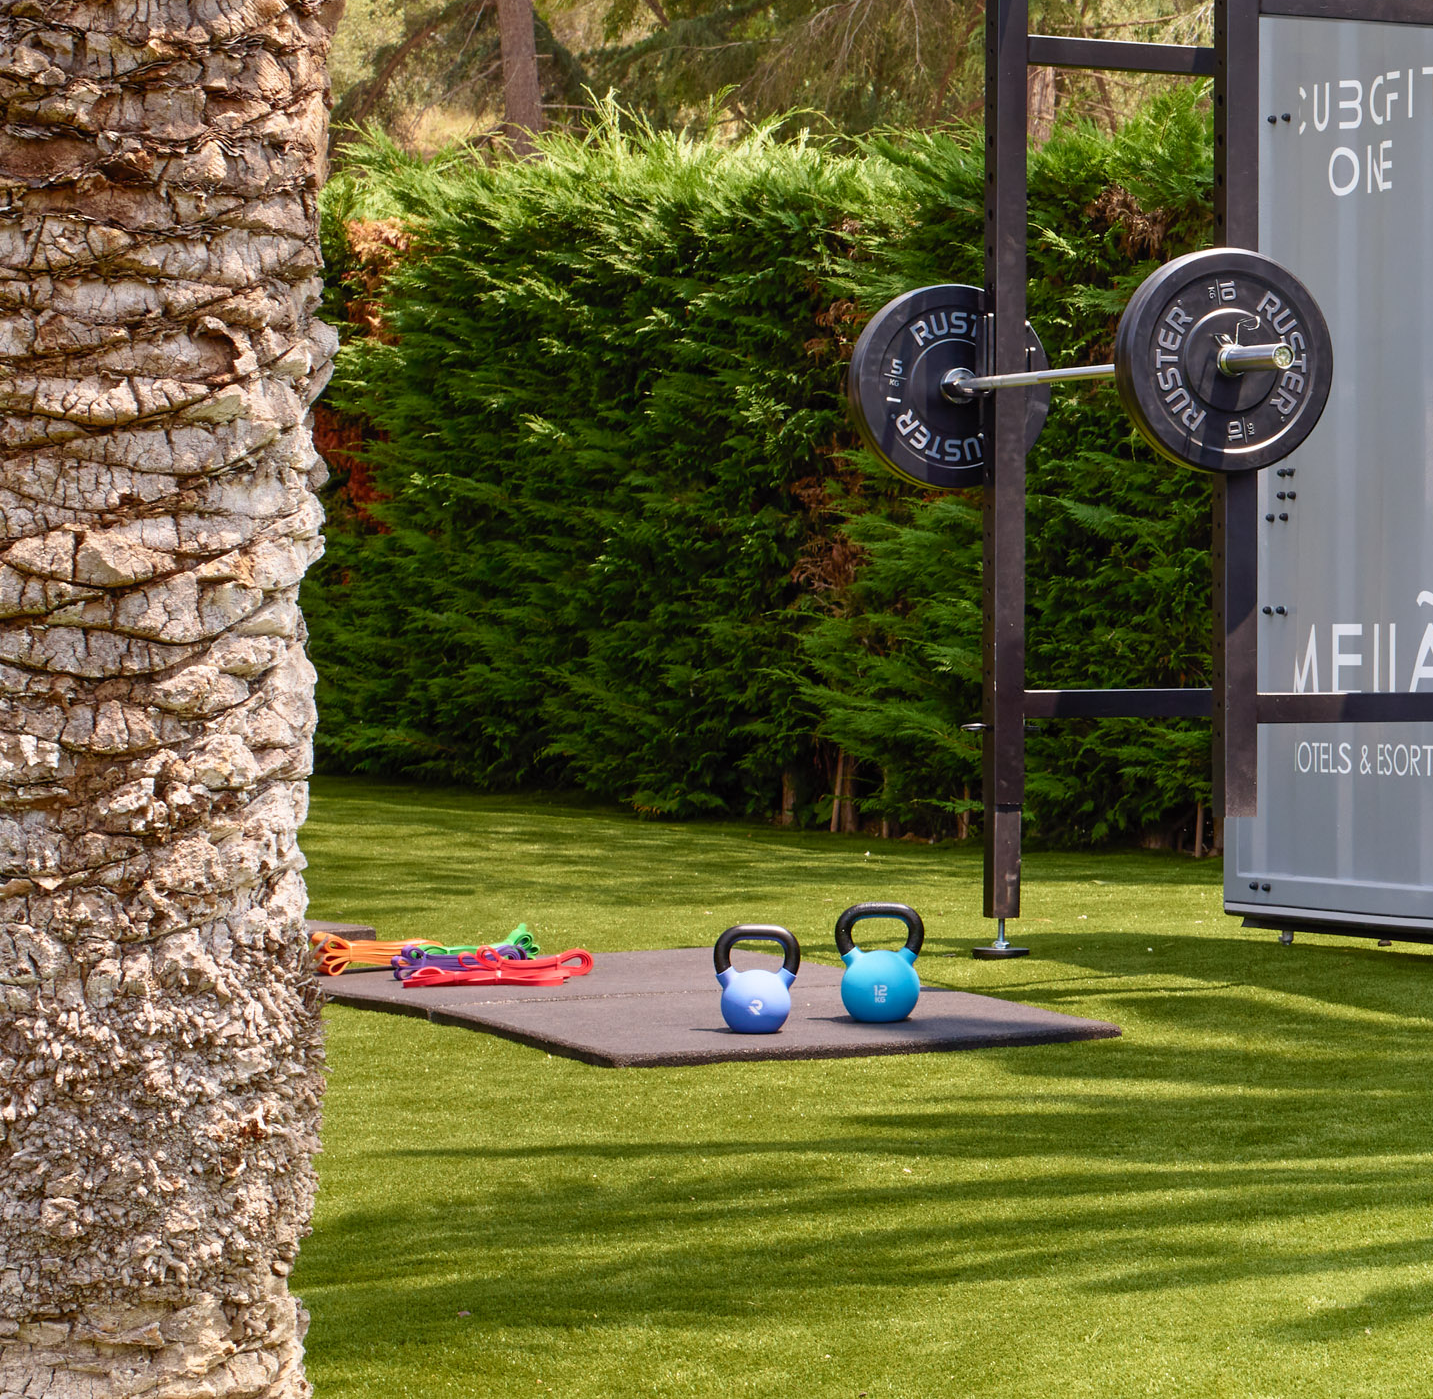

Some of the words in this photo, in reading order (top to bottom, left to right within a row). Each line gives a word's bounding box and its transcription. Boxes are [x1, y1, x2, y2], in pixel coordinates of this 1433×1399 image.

[1327, 139, 1393, 197] ONE
[1219, 280, 1237, 302] 10
[1256, 290, 1307, 416] RUSTER
[1155, 306, 1207, 432] RUSTER
[1359, 744, 1372, 775] &
[873, 984, 888, 997] 12
[874, 996, 887, 1004] KG
